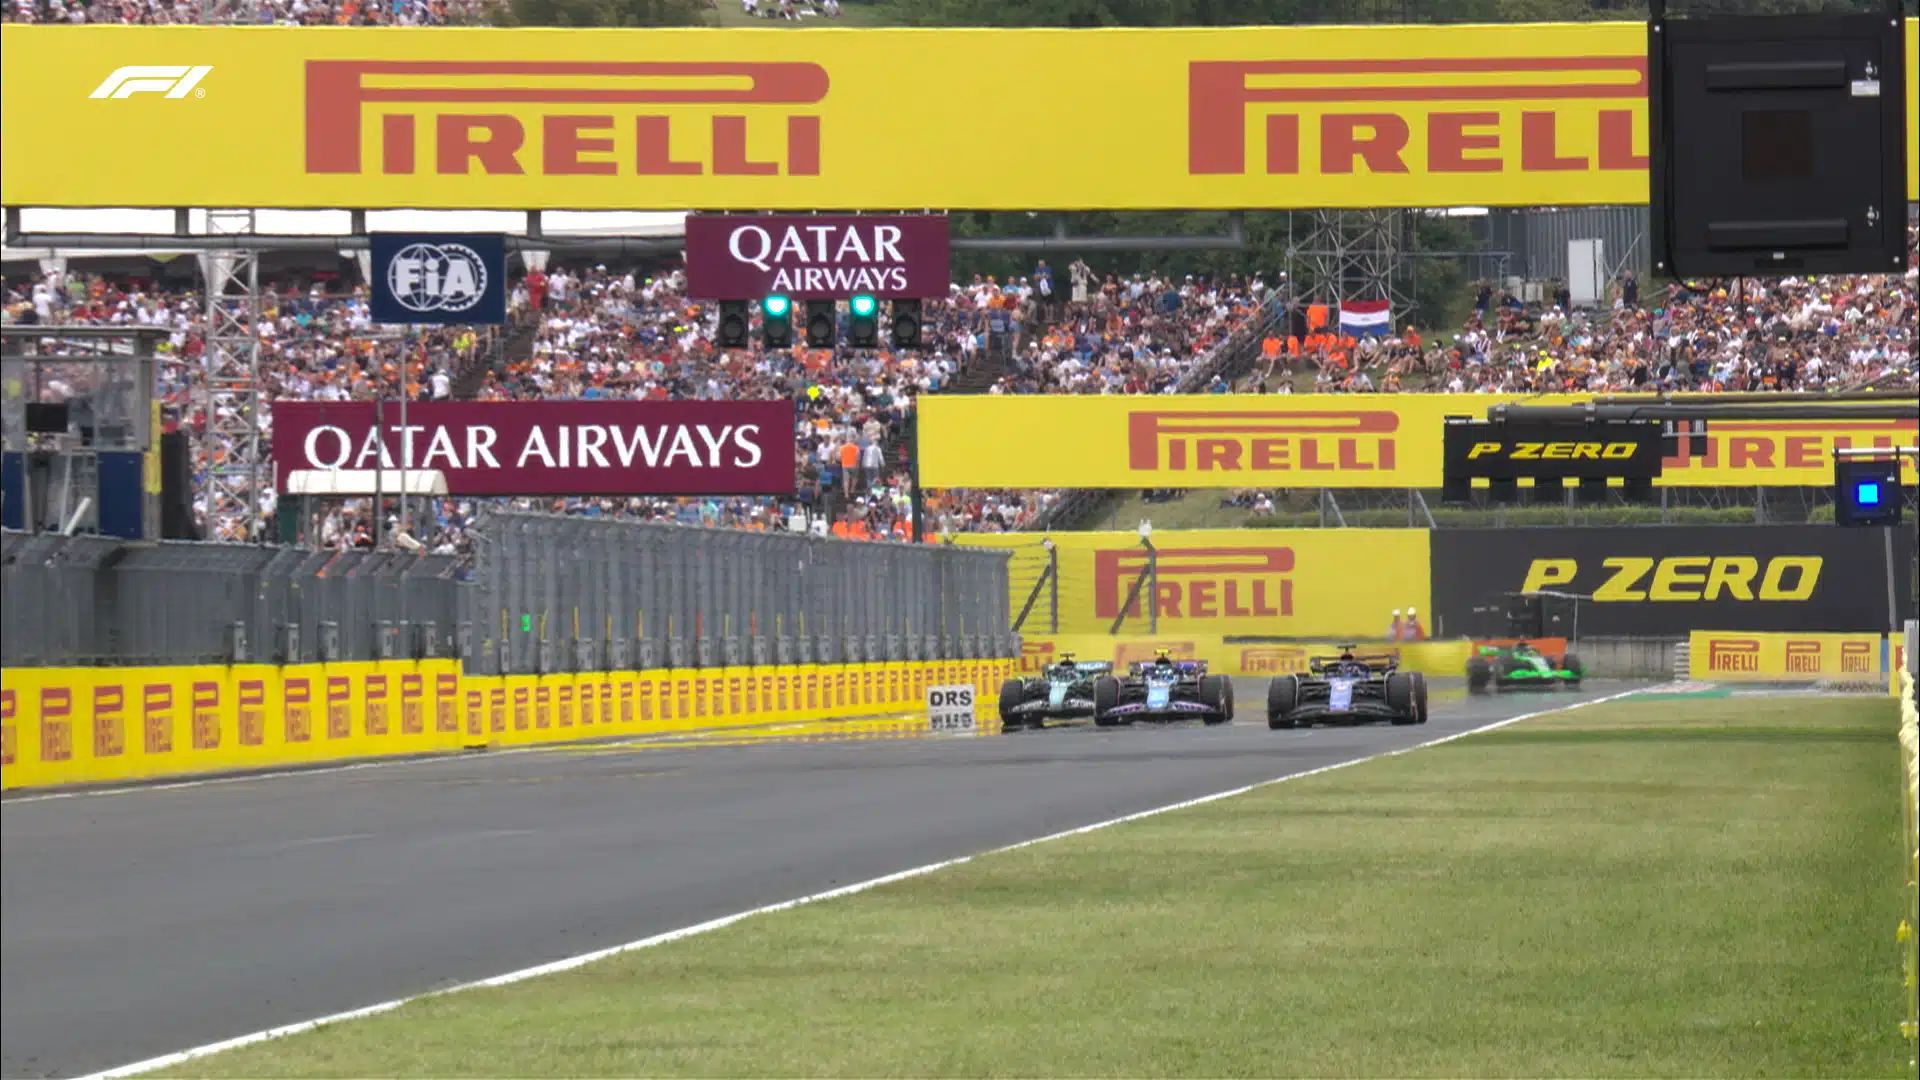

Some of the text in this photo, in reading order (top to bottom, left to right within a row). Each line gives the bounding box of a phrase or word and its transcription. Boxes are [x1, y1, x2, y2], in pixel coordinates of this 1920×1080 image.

[304, 60, 830, 175] PIRELLI
[1188, 55, 1649, 174] PIRELL
[728, 225, 906, 272] QATAR
[771, 267, 908, 291] AIRWAYS
[304, 424, 762, 471] QATAR AIRWAYS
[1128, 411, 1399, 471] PIRELLI
[1467, 442, 1637, 459] P ZERO
[1095, 547, 1295, 618] PIRELLI
[1520, 555, 1823, 602] P ZERO
[1709, 640, 1760, 672] PIRELLI
[1786, 641, 1821, 673] PIRELLI
[930, 690, 972, 706] DRS
